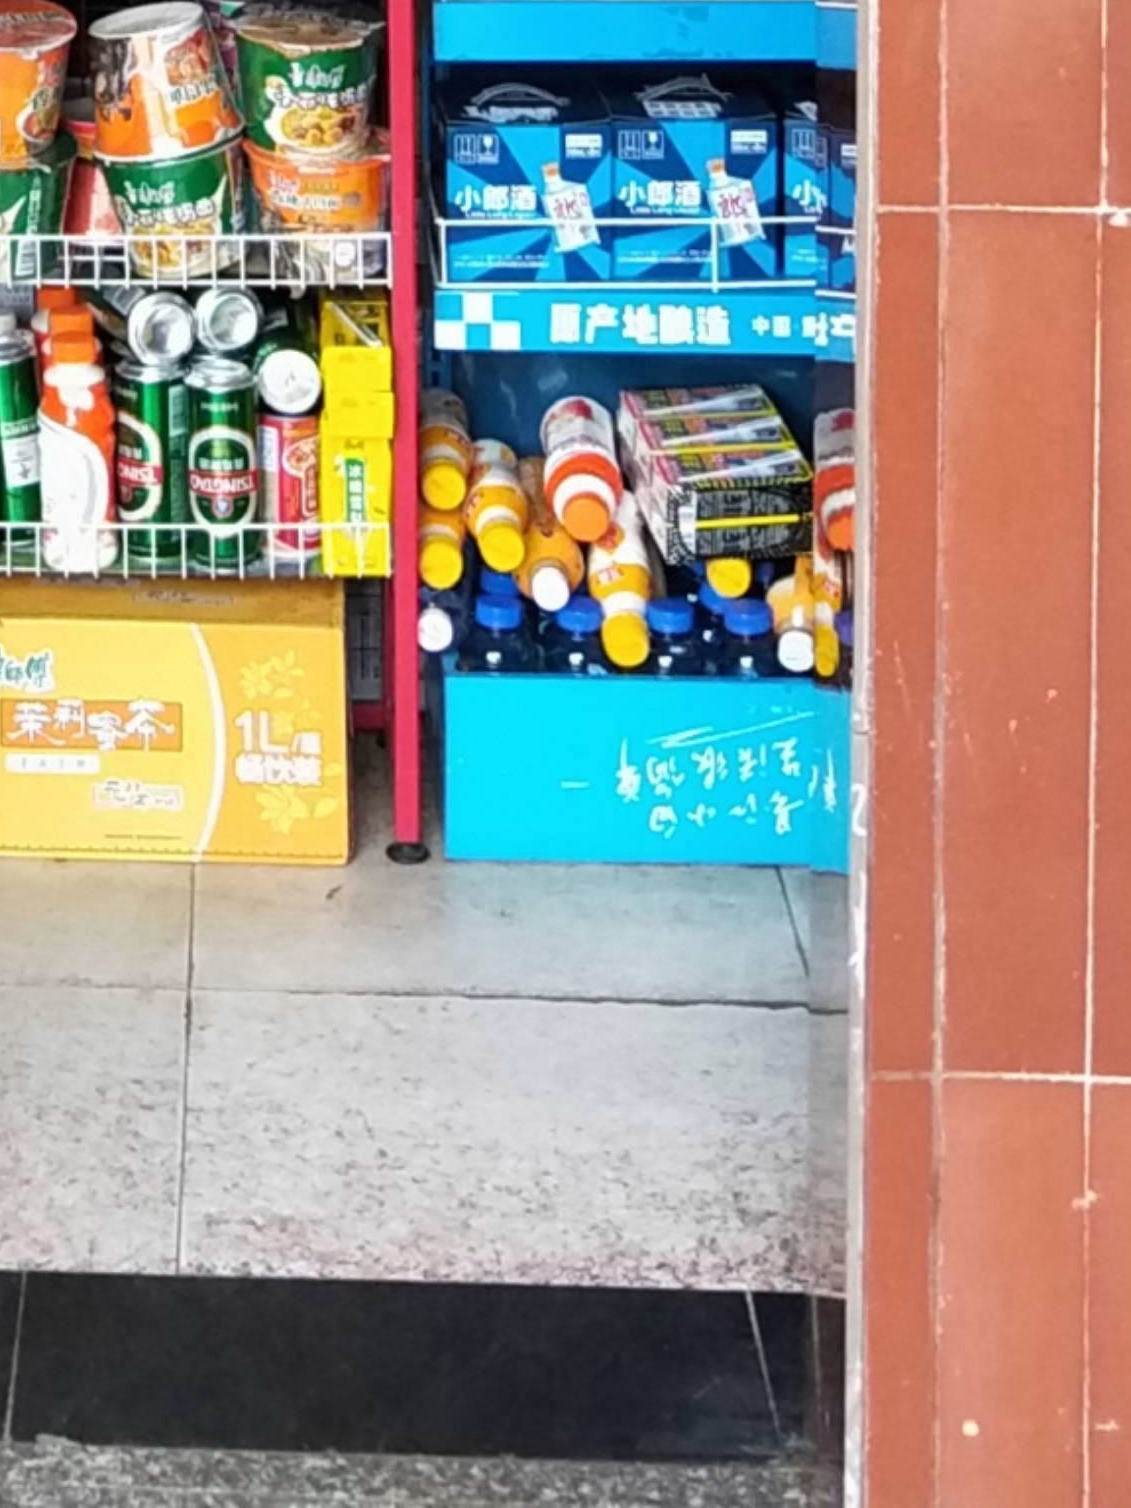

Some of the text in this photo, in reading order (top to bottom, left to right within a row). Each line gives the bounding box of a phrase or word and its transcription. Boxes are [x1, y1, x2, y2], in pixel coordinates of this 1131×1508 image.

[455, 183, 537, 213] 小郎酒
[618, 179, 701, 208] 小郎酒
[550, 302, 731, 346] 原产地酿造
[5, 698, 176, 752] 茉莉蜜茶
